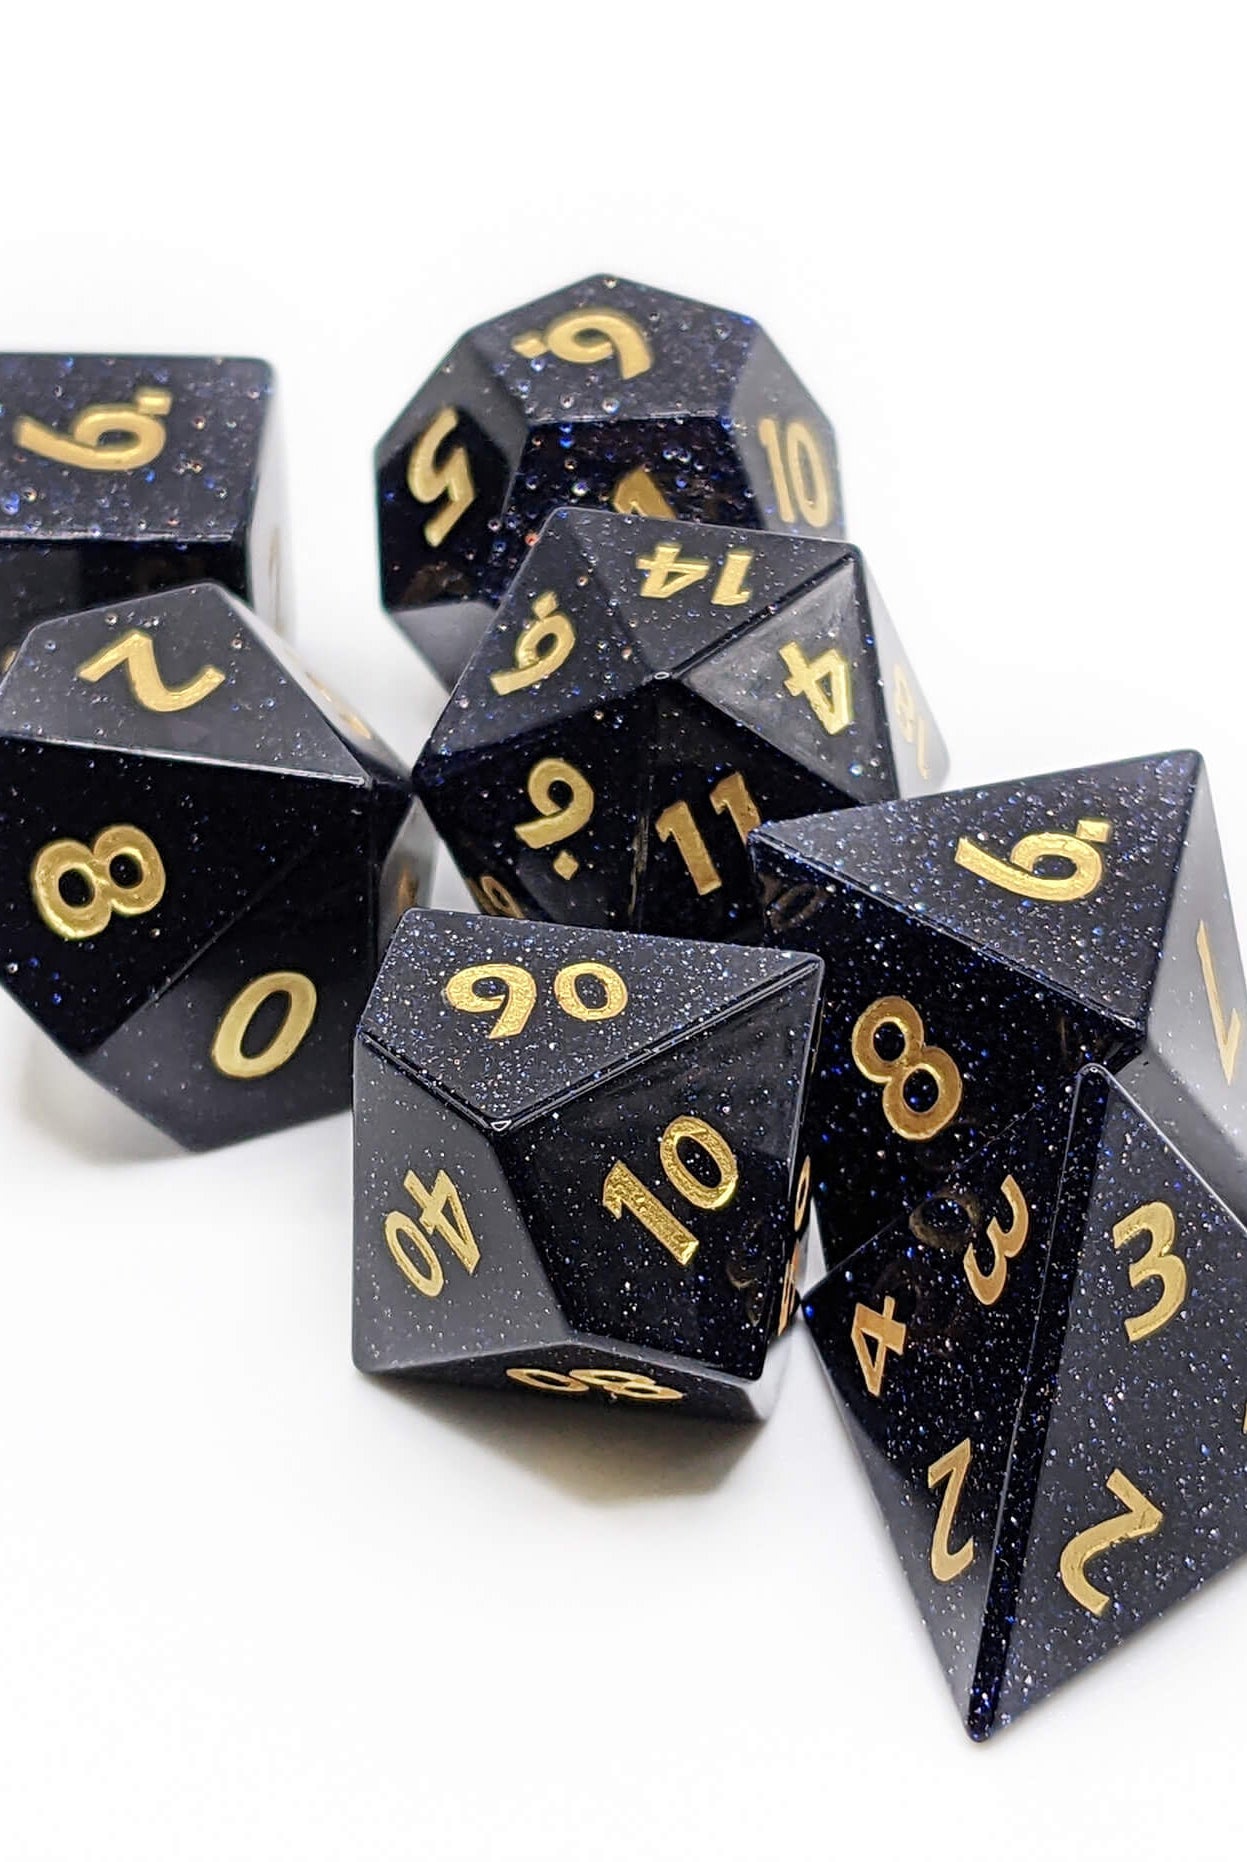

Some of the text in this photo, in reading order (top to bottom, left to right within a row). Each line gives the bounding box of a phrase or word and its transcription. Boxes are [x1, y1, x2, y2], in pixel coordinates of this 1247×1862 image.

[407, 407, 476, 547] 5
[758, 416, 831, 527] 10
[636, 541, 755, 607] 14
[77, 629, 226, 714] 2
[779, 640, 854, 737] 4
[32, 824, 167, 940] 8
[655, 771, 762, 896] 11
[210, 970, 318, 1080] 0
[444, 960, 629, 1040] 90
[851, 996, 963, 1141] 8
[384, 1169, 481, 1299] 40
[601, 1114, 740, 1267] 10
[963, 1174, 1030, 1306] 3
[1112, 1200, 1189, 1343] 3
[850, 1295, 909, 1397] 4
[927, 1437, 976, 1583] 2
[1059, 1468, 1166, 1616] 2
